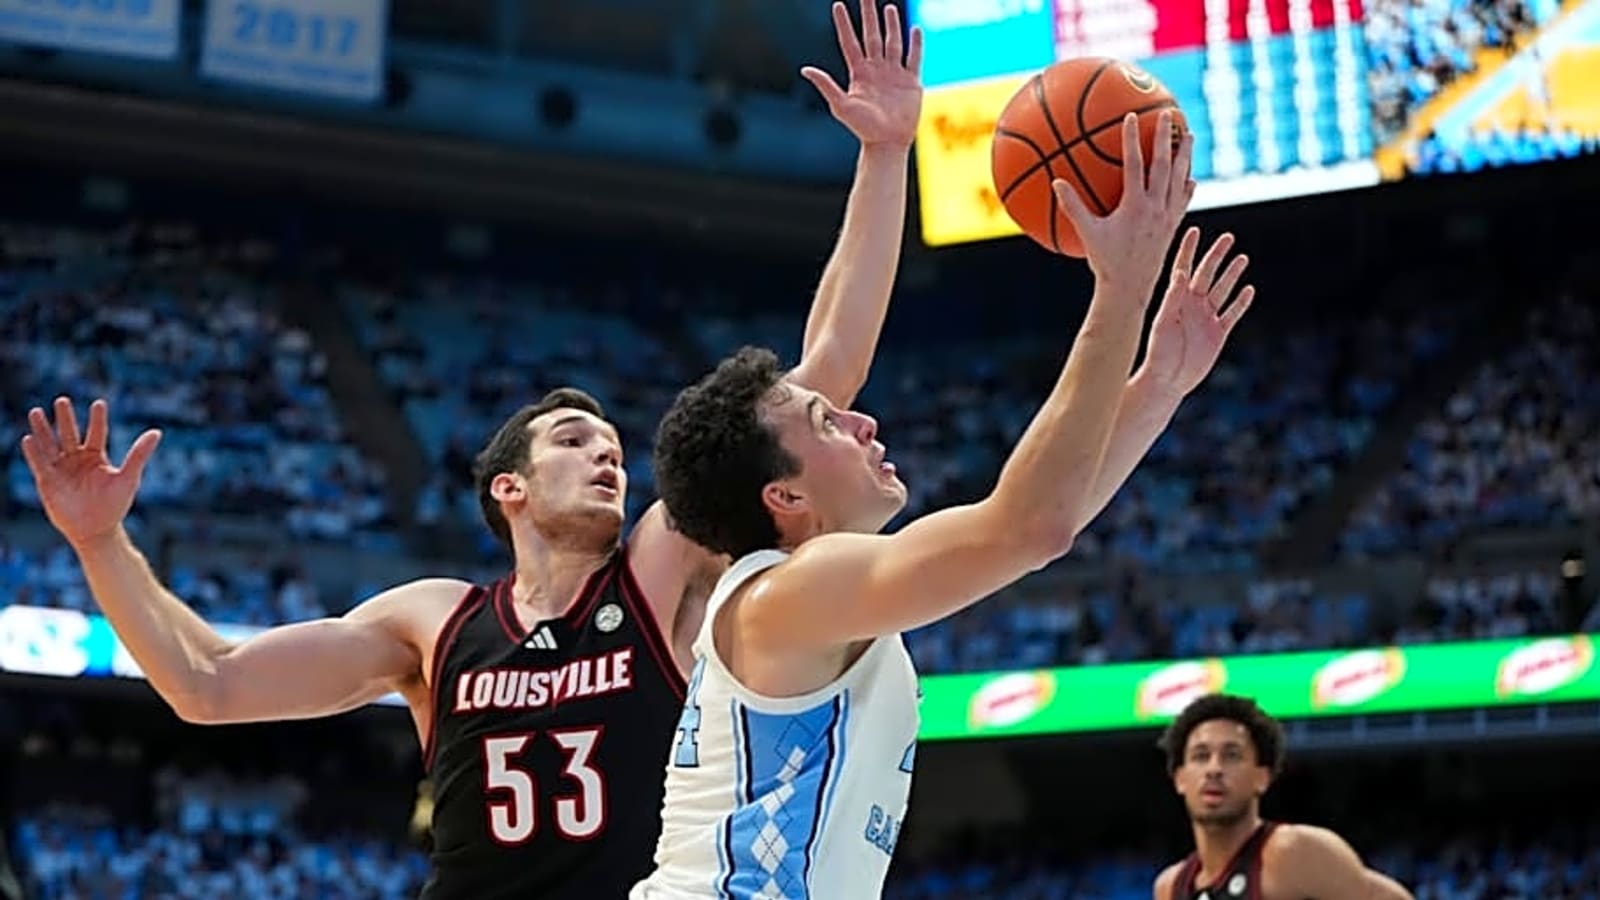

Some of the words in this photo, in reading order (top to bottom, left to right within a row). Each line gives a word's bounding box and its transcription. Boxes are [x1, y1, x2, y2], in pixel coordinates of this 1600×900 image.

[233, 4, 359, 56] 2017
[454, 648, 633, 713] LOUISVILLE
[483, 726, 607, 846] 53
